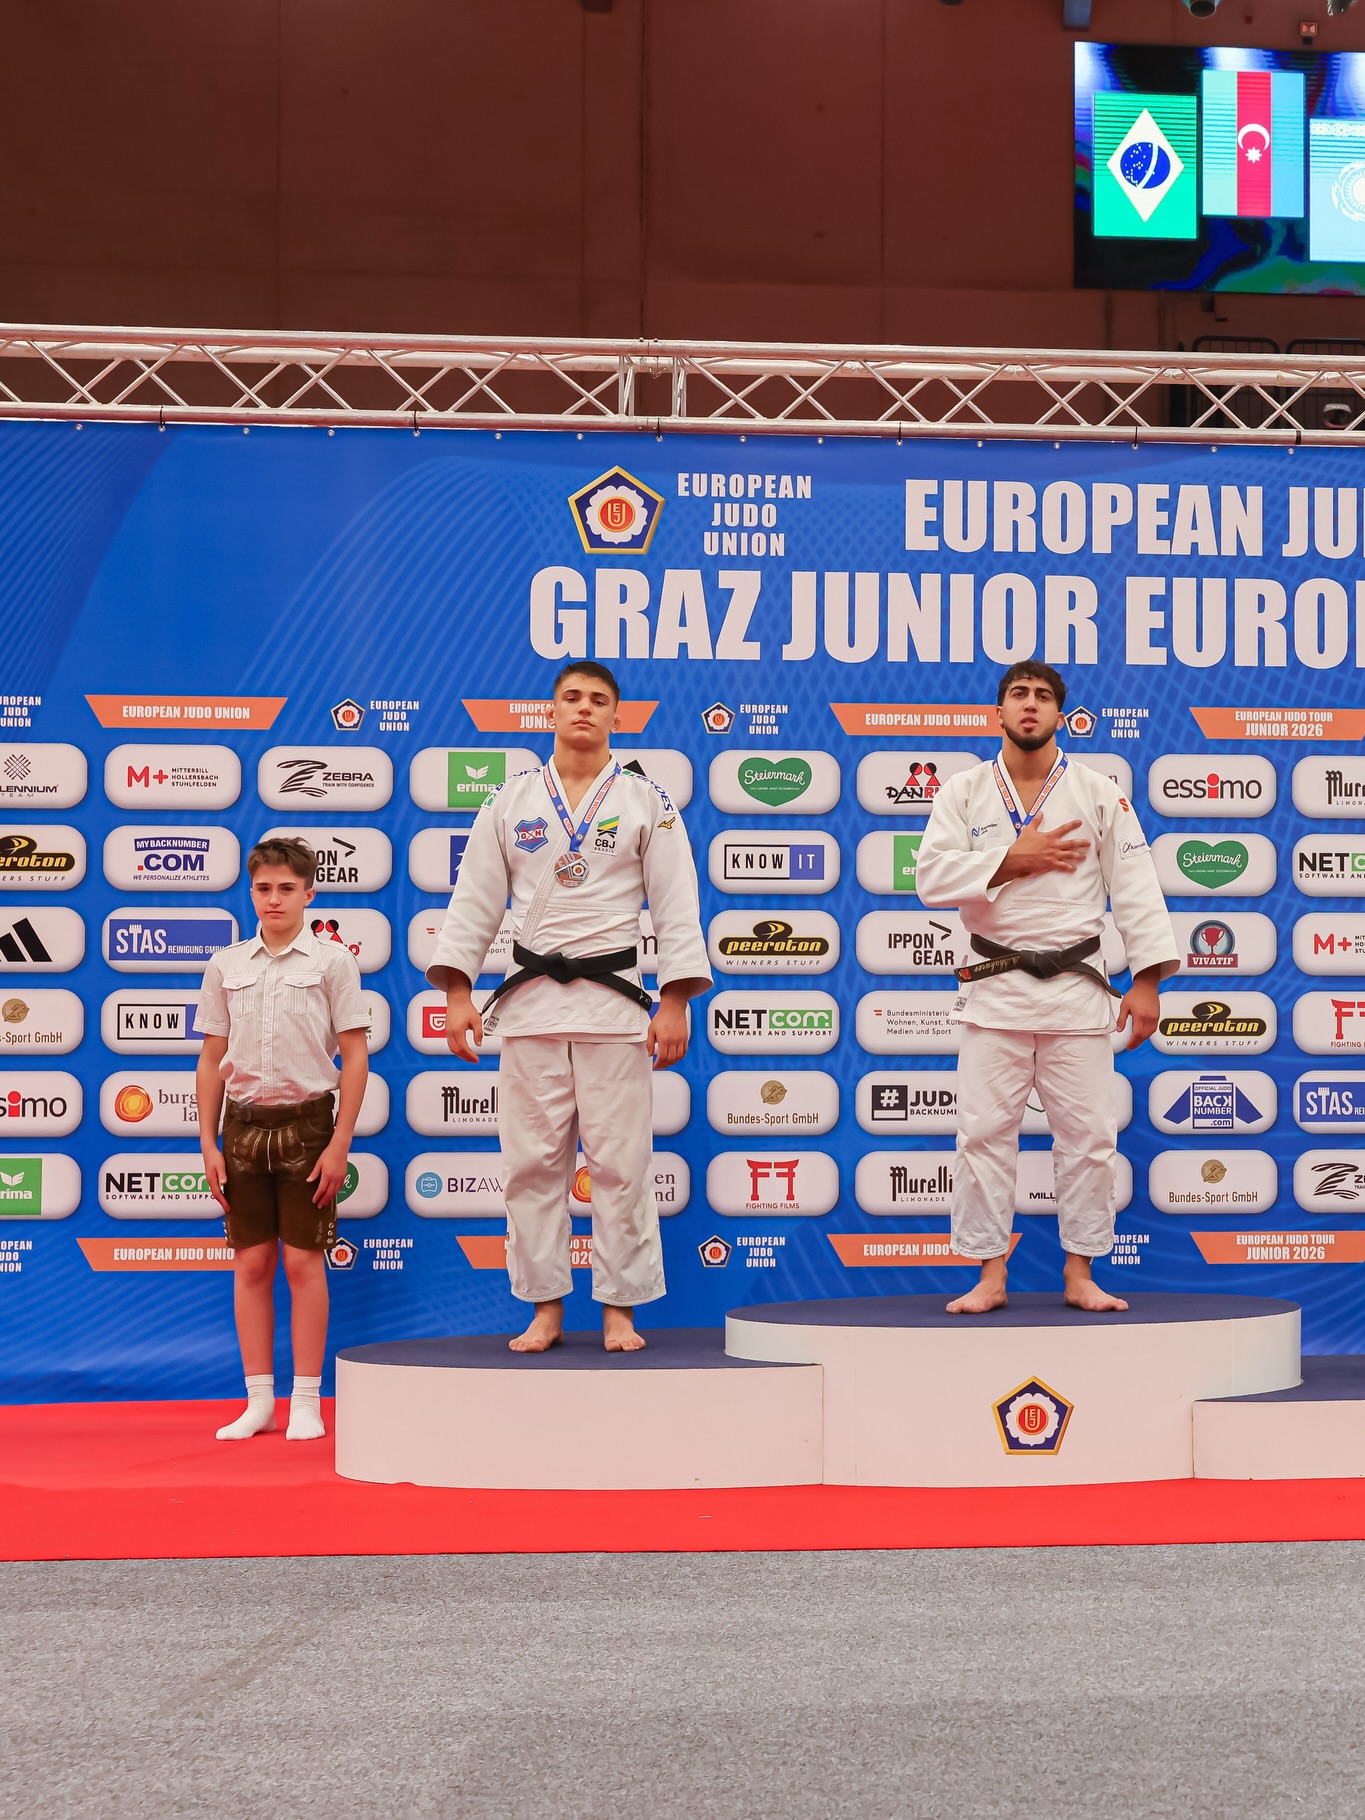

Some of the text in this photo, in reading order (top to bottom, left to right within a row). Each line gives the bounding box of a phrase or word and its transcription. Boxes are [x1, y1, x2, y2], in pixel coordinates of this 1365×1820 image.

[678, 472, 812, 499] EUROPEAN
[711, 503, 777, 529] JUDO
[906, 479, 1263, 556] EUROPEAN
[703, 531, 785, 557] UNION
[530, 566, 761, 661] GRAZ
[783, 571, 1097, 666] JUNIOR
[122, 705, 250, 720] EUROPEAN JUDO UNION
[370, 700, 420, 711] EUROPEAN
[382, 711, 407, 721] JUDO
[1101, 708, 1150, 719] EUROPEAN
[1235, 711, 1333, 722] EUROPEAN JUDO TOUR
[379, 722, 410, 732] UNION
[1113, 718, 1138, 729] JUDO
[1245, 723, 1324, 737] JUNIOR 2026
[1110, 728, 1140, 739] UNION
[322, 772, 374, 782] ZEBRA
[744, 768, 806, 785] Steiermark
[456, 781, 497, 792] erima
[1162, 773, 1262, 799] essimo
[595, 838, 616, 850] CBJ
[137, 853, 205, 871] .COM
[732, 853, 815, 870] KNOW IT
[1182, 851, 1243, 868] Steiermark
[726, 939, 822, 953] peeroton
[888, 933, 934, 949] IPPON
[912, 950, 955, 965] GEAR
[1192, 956, 1234, 966] VIVATIP
[1166, 1020, 1259, 1034] peeroton
[1194, 1095, 1232, 1107] BACK
[1306, 1087, 1353, 1116] STAS
[1194, 1107, 1232, 1115] NUMBER
[727, 1112, 819, 1126] Bundes-Sport GmbH
[1169, 1191, 1258, 1204] Bundes-Sport GmbH
[363, 1238, 414, 1249] EUROPEAN
[1236, 1234, 1335, 1245] EUROPEAN JUDO TOUR
[113, 1247, 205, 1261] EUROPEAN JUDO
[375, 1249, 401, 1259] JUDO
[1246, 1246, 1326, 1261] JUNIOR 2026
[372, 1260, 404, 1270] UNION
